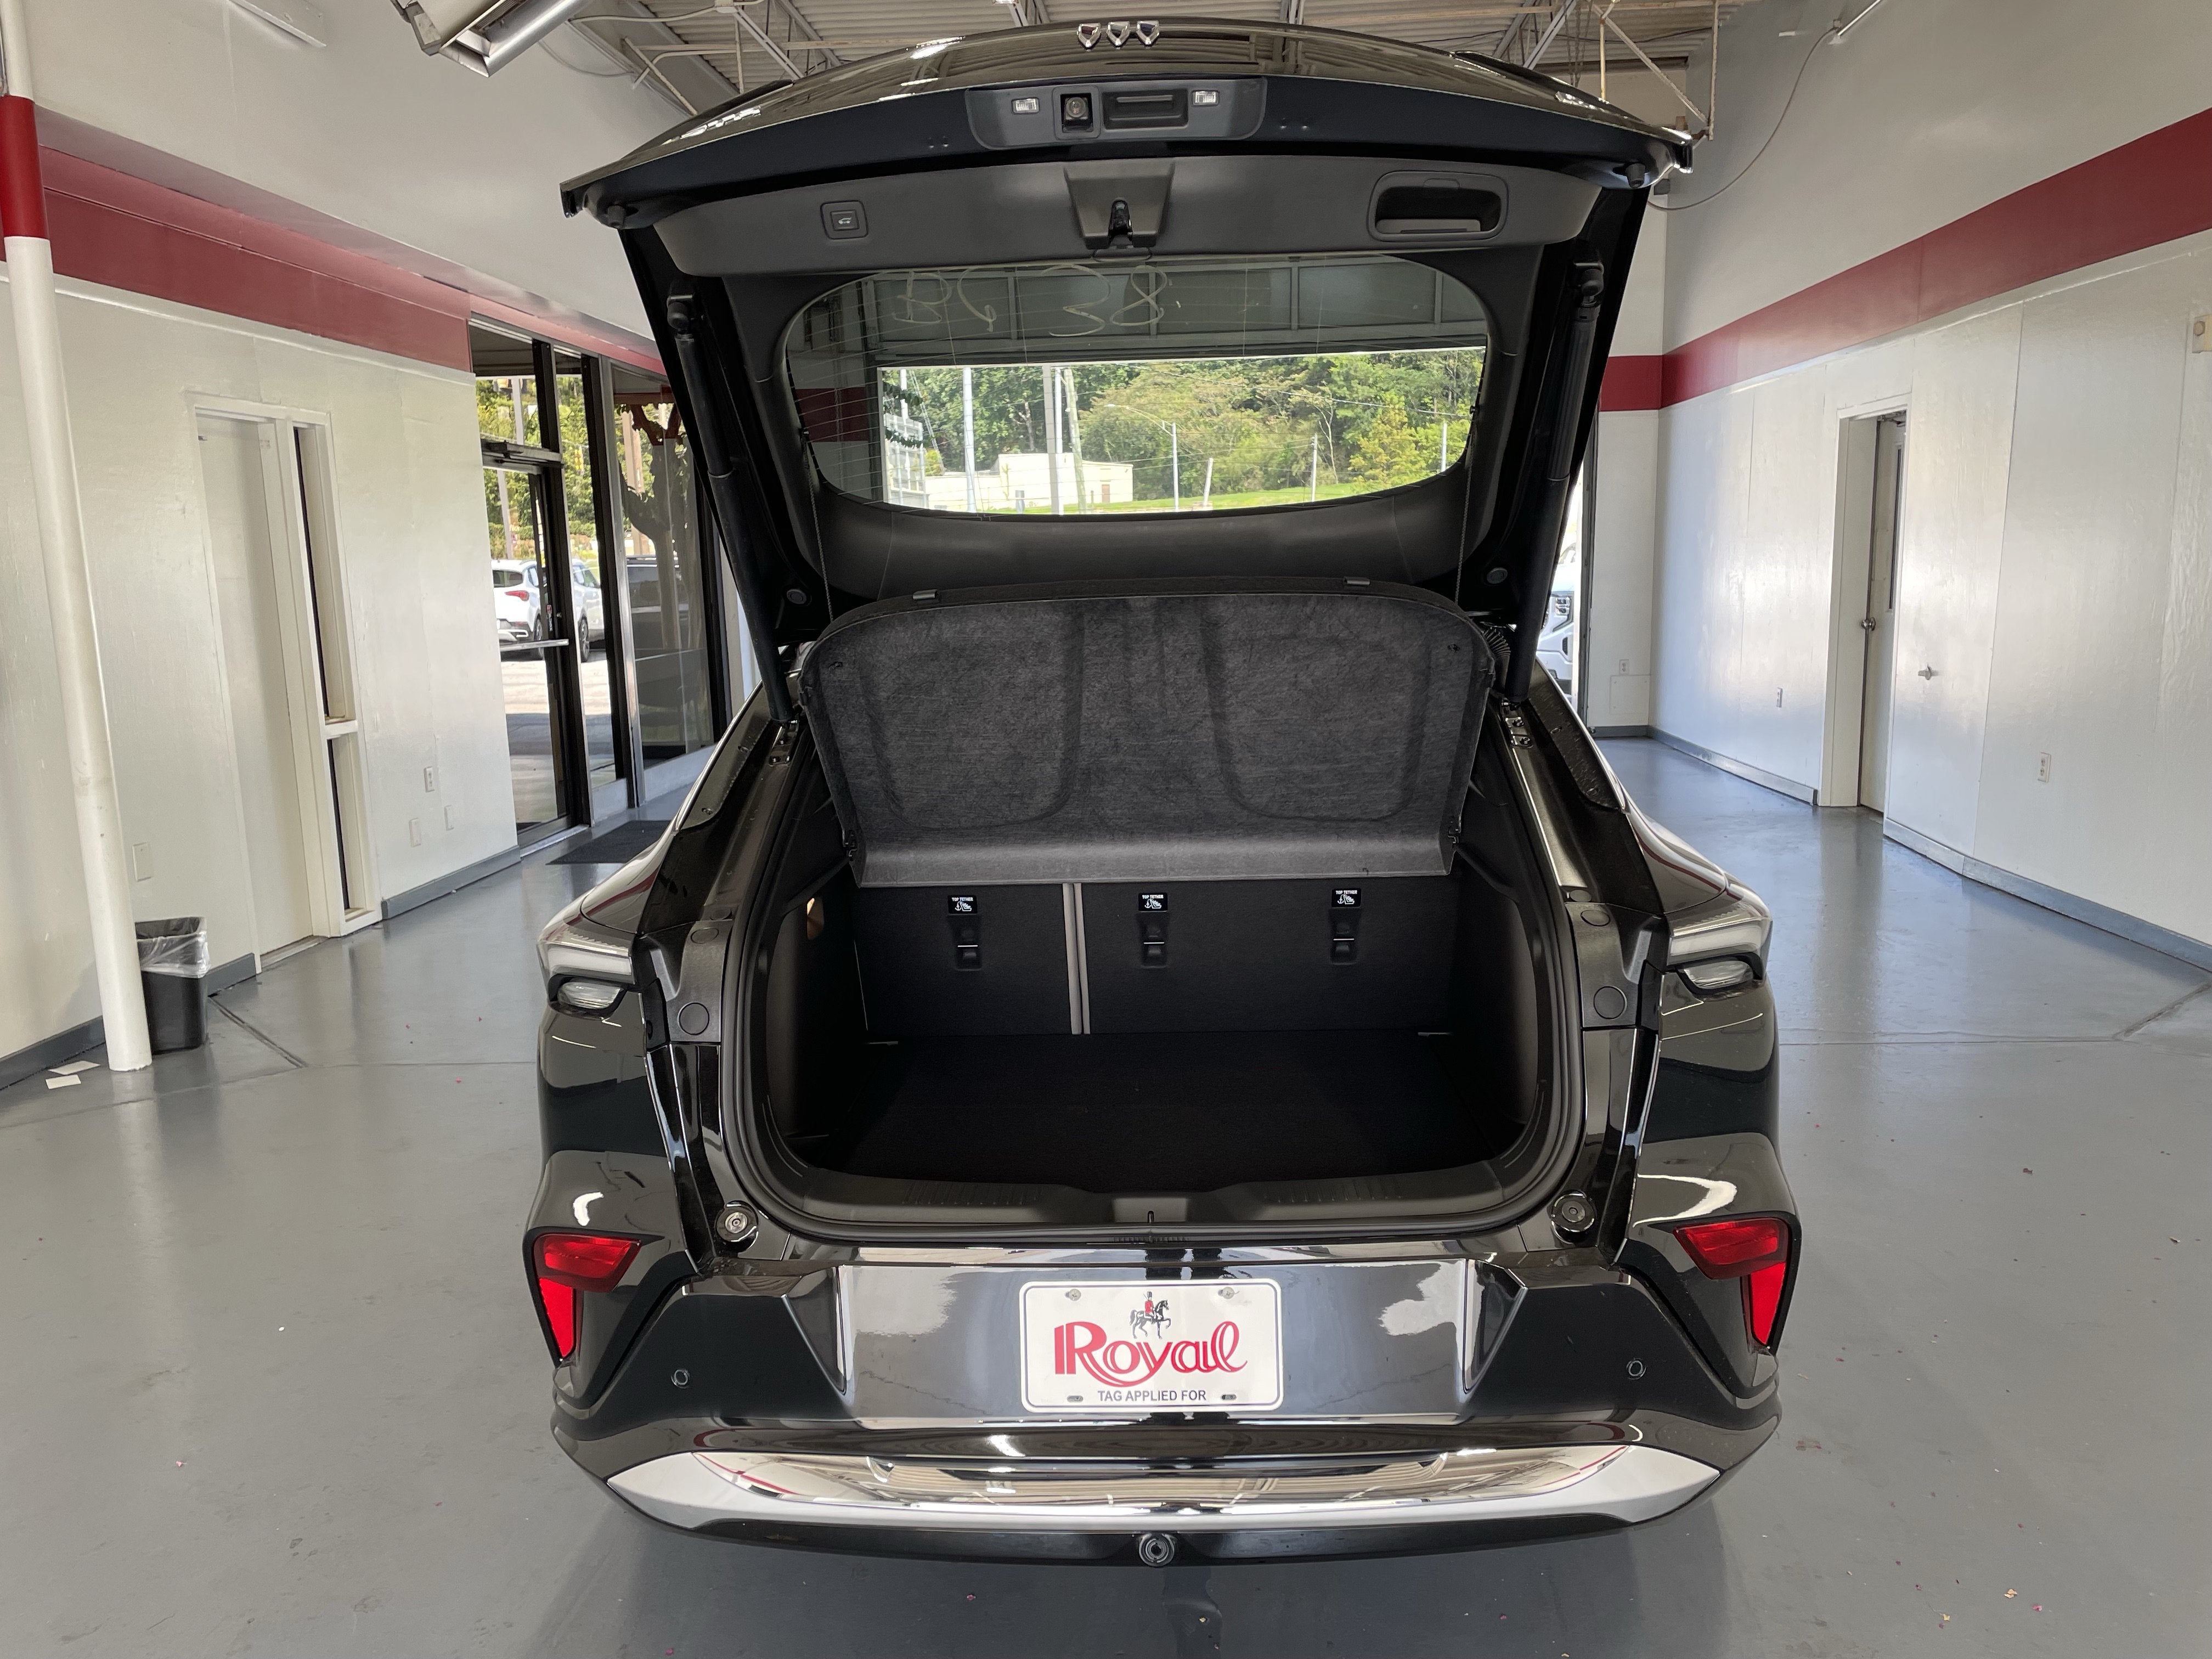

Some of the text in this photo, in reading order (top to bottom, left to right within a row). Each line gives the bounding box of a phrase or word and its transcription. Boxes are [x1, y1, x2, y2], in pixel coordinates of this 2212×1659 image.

[1054, 1321, 1247, 1387] Royal
[1098, 1390, 1207, 1402] TAG APPLIED FOR
